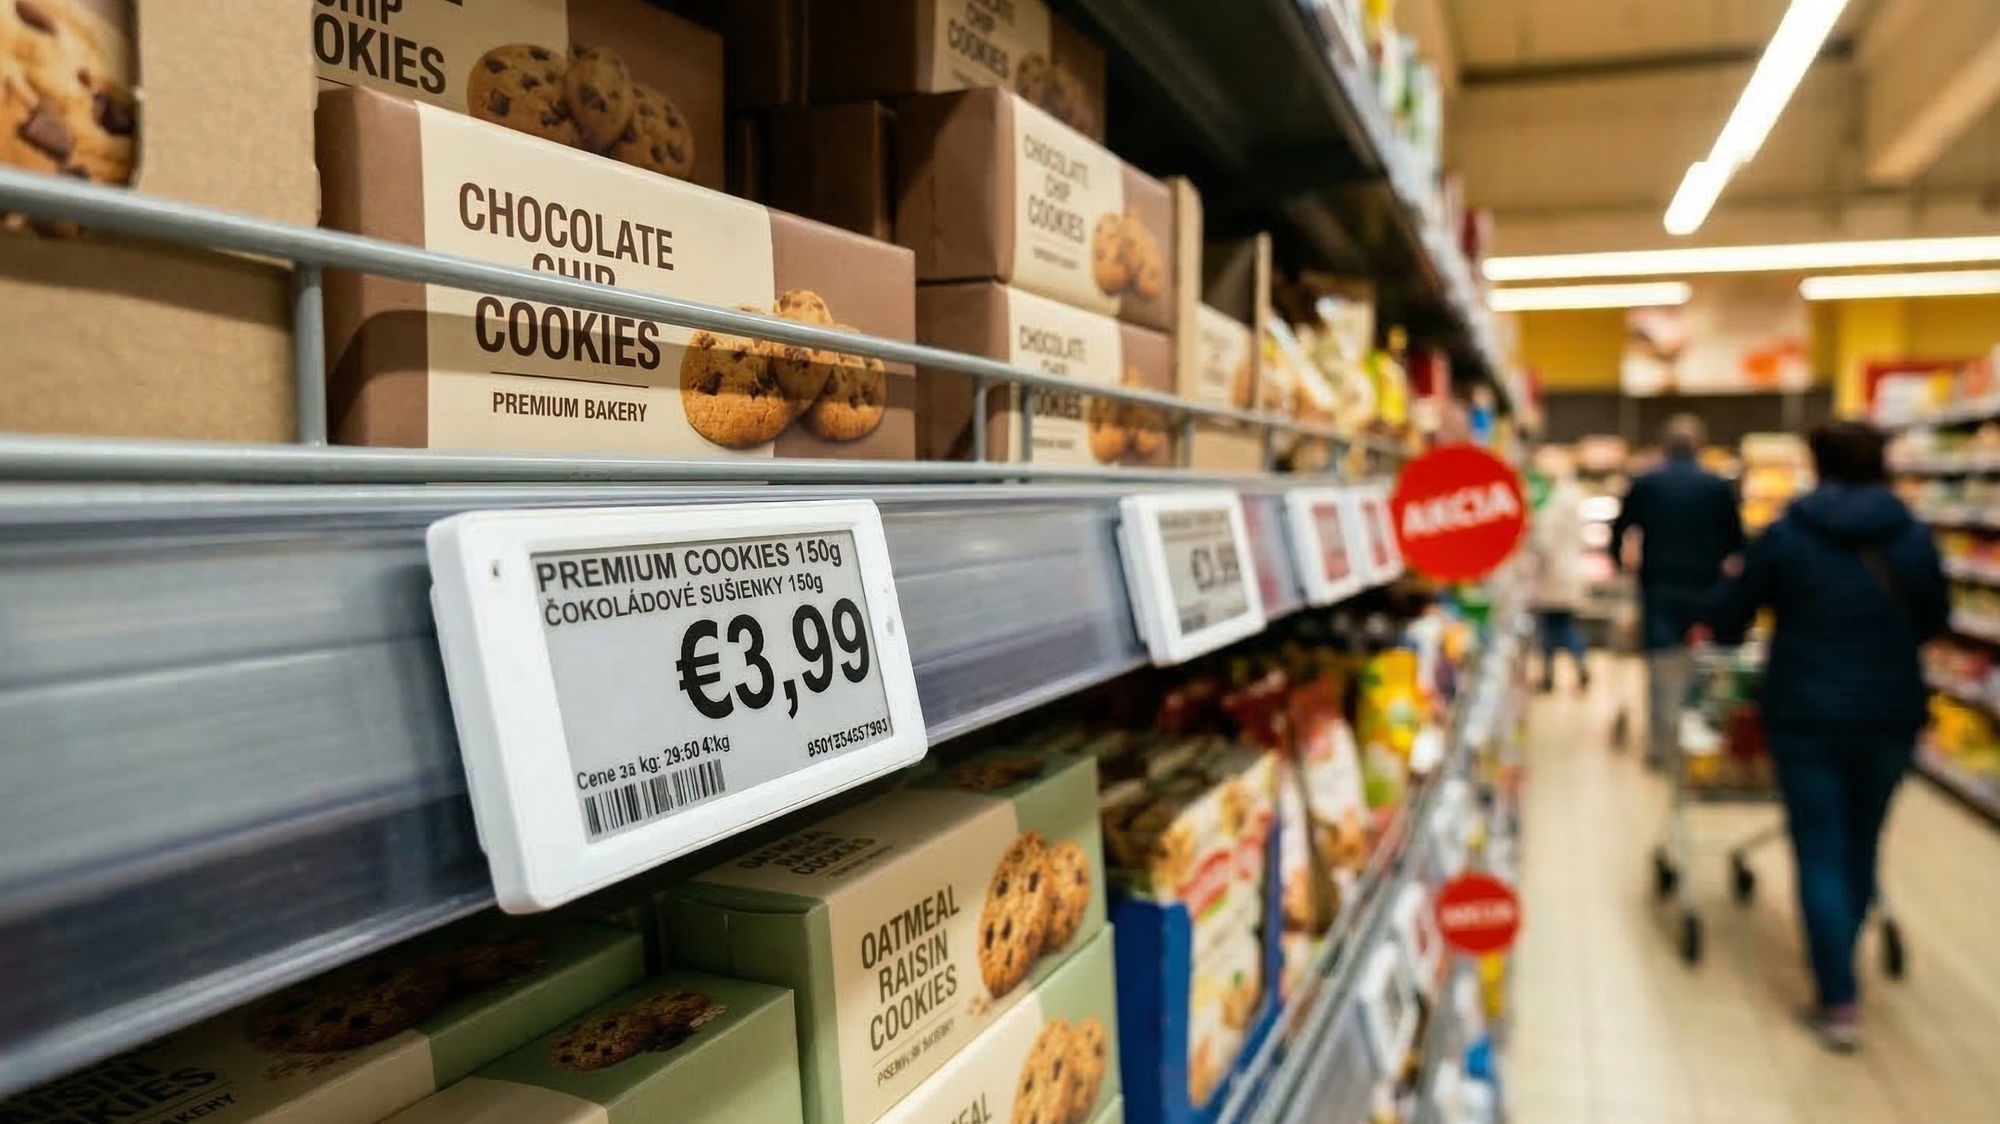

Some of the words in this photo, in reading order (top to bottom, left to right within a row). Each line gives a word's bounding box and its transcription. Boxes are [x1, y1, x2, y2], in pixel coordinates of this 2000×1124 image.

[458, 182, 675, 271] CHOCOLATE
[475, 296, 661, 371] COOKIES
[492, 392, 579, 418] PREMIUM
[585, 398, 647, 423] BAKERY
[536, 552, 677, 592] PREMIUM
[684, 542, 790, 576] COOKIES
[795, 539, 842, 567] 150g
[544, 582, 697, 626] ČOKOLÁDOVÉ
[701, 576, 783, 605] SUŠIENKY
[788, 572, 824, 594] 150g
[676, 597, 870, 720] €3,99
[861, 884, 960, 970] OATMEAL
[878, 928, 949, 1005] RAISIN
[870, 963, 958, 1052] COOKIES
